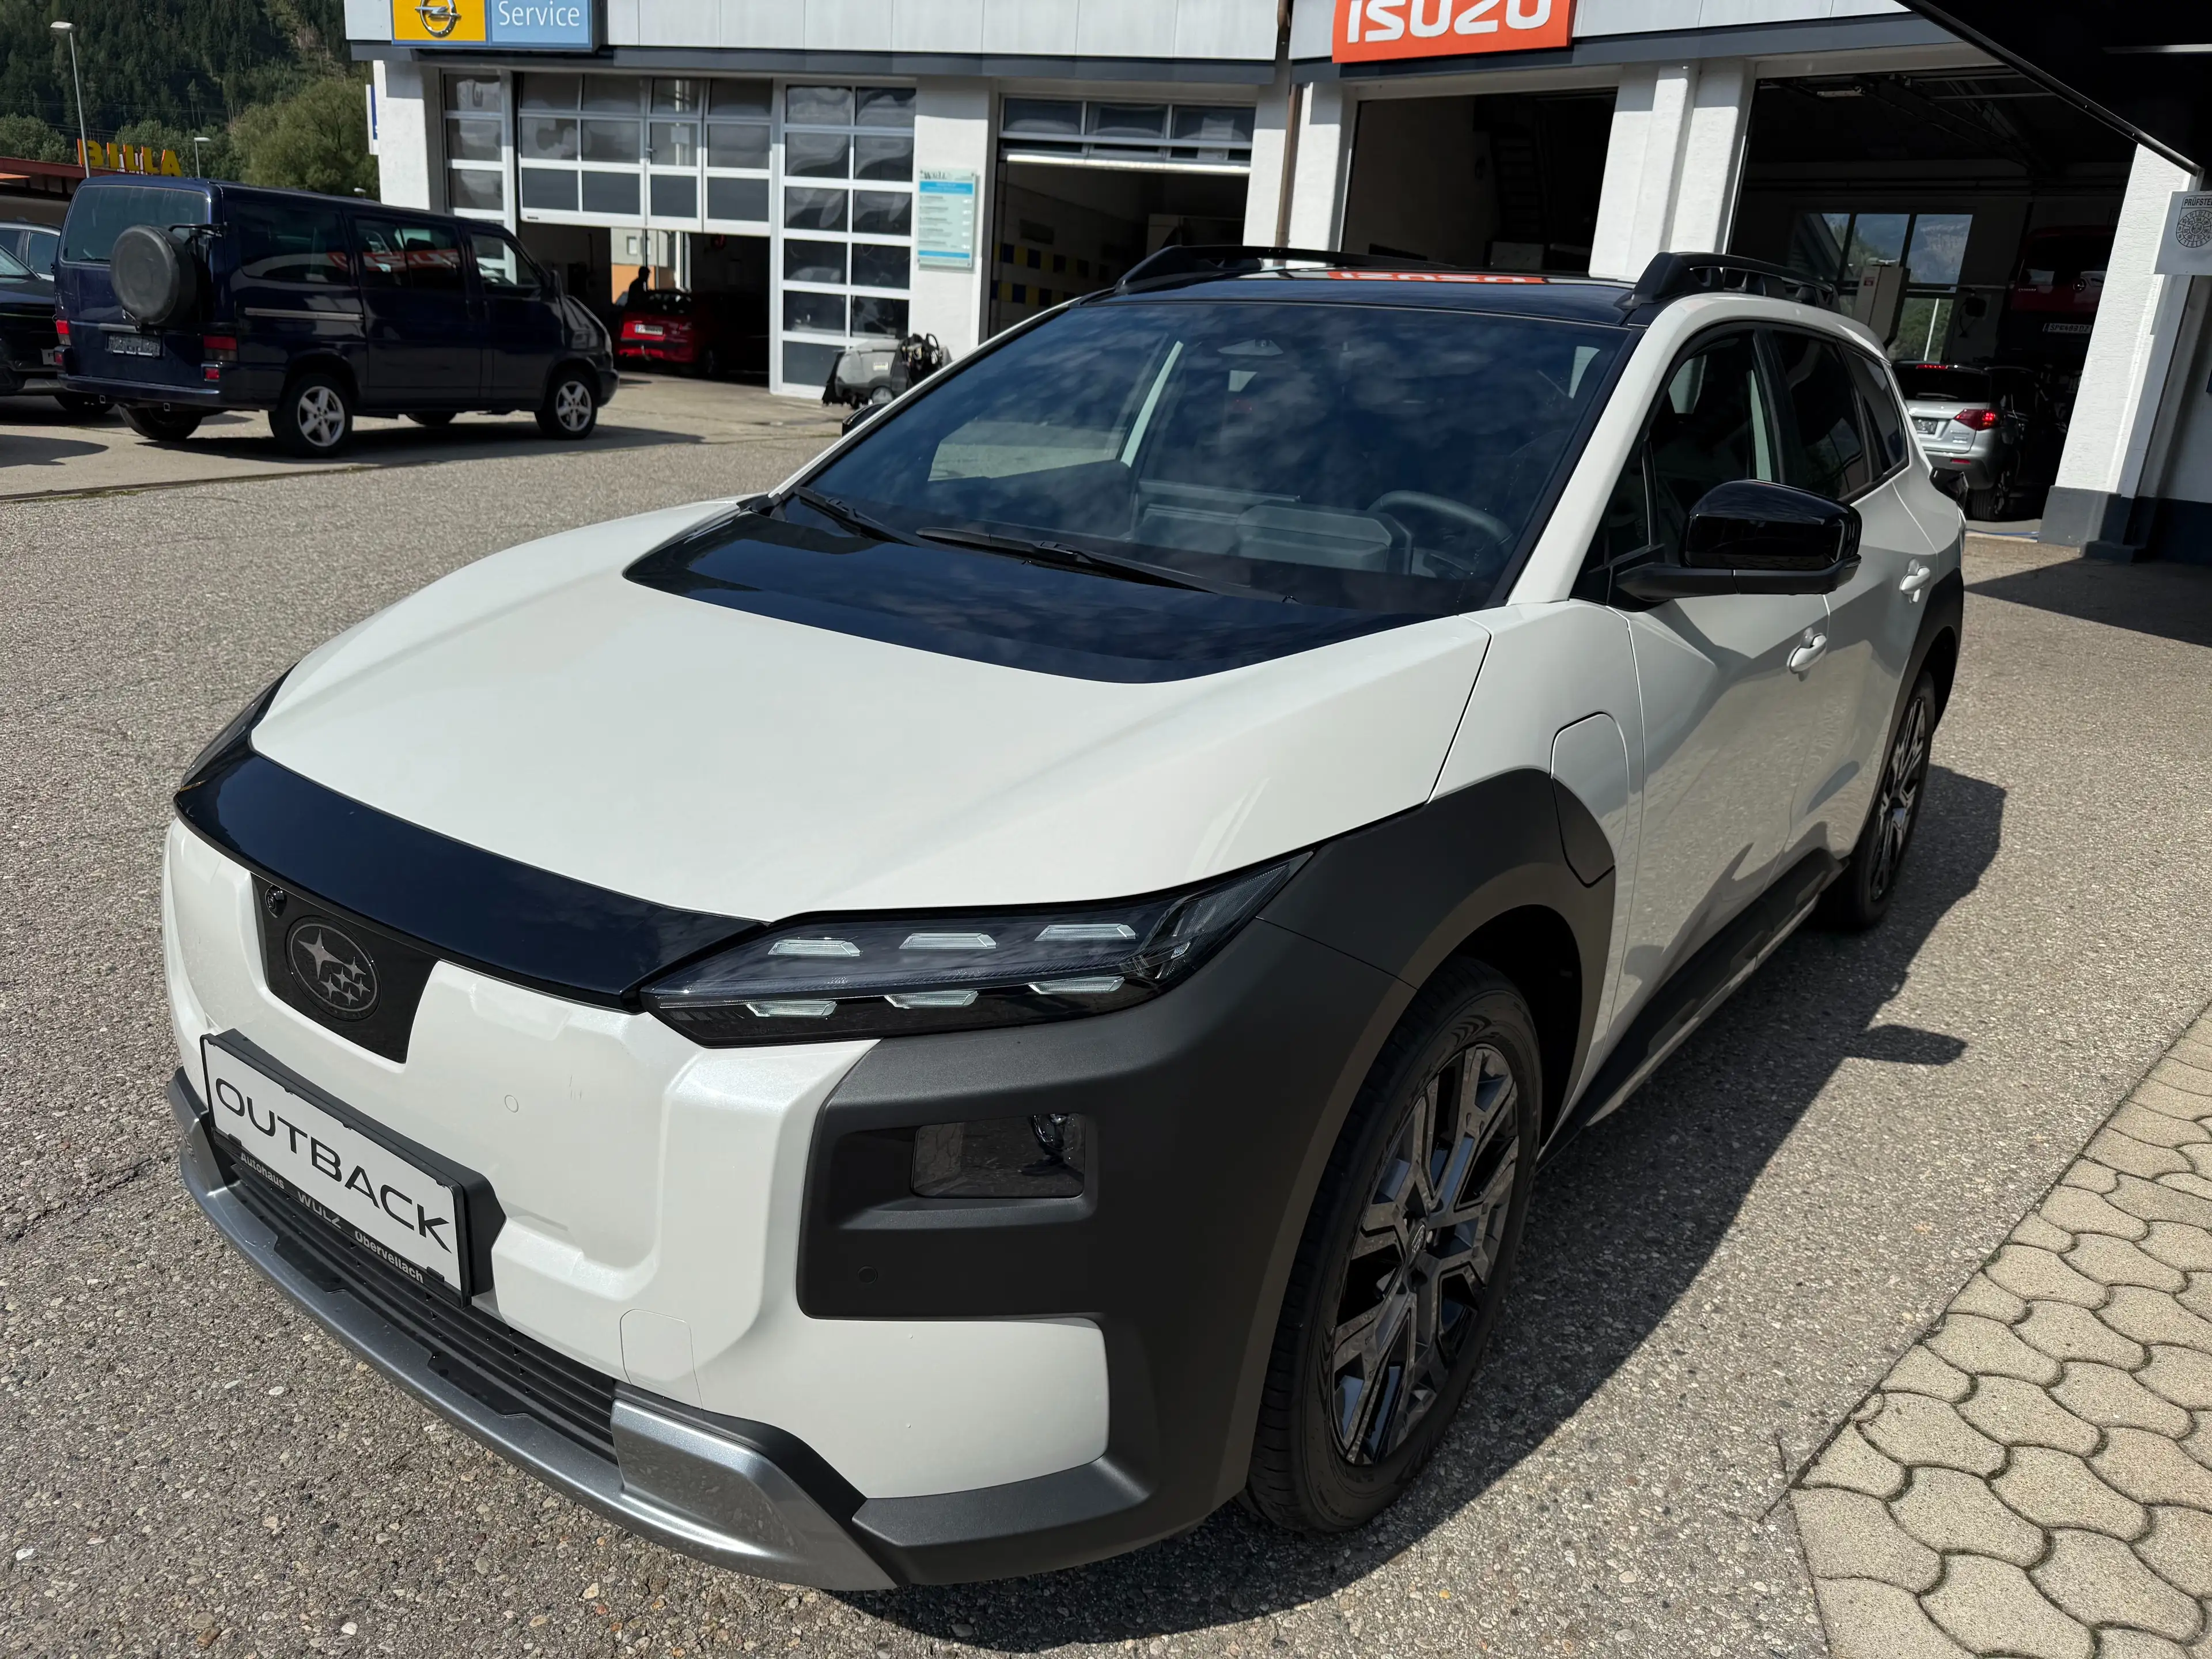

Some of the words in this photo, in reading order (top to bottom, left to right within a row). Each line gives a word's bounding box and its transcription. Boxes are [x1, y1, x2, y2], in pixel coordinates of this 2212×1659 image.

[498, 1, 580, 26] Service
[1347, 0, 1552, 44] ISUZU
[77, 138, 182, 177] BILLA
[215, 1078, 452, 1254] OUTBACK
[241, 1152, 285, 1190] Autohaus
[297, 1191, 342, 1229] WULZ
[354, 1230, 424, 1283] Obervellach
